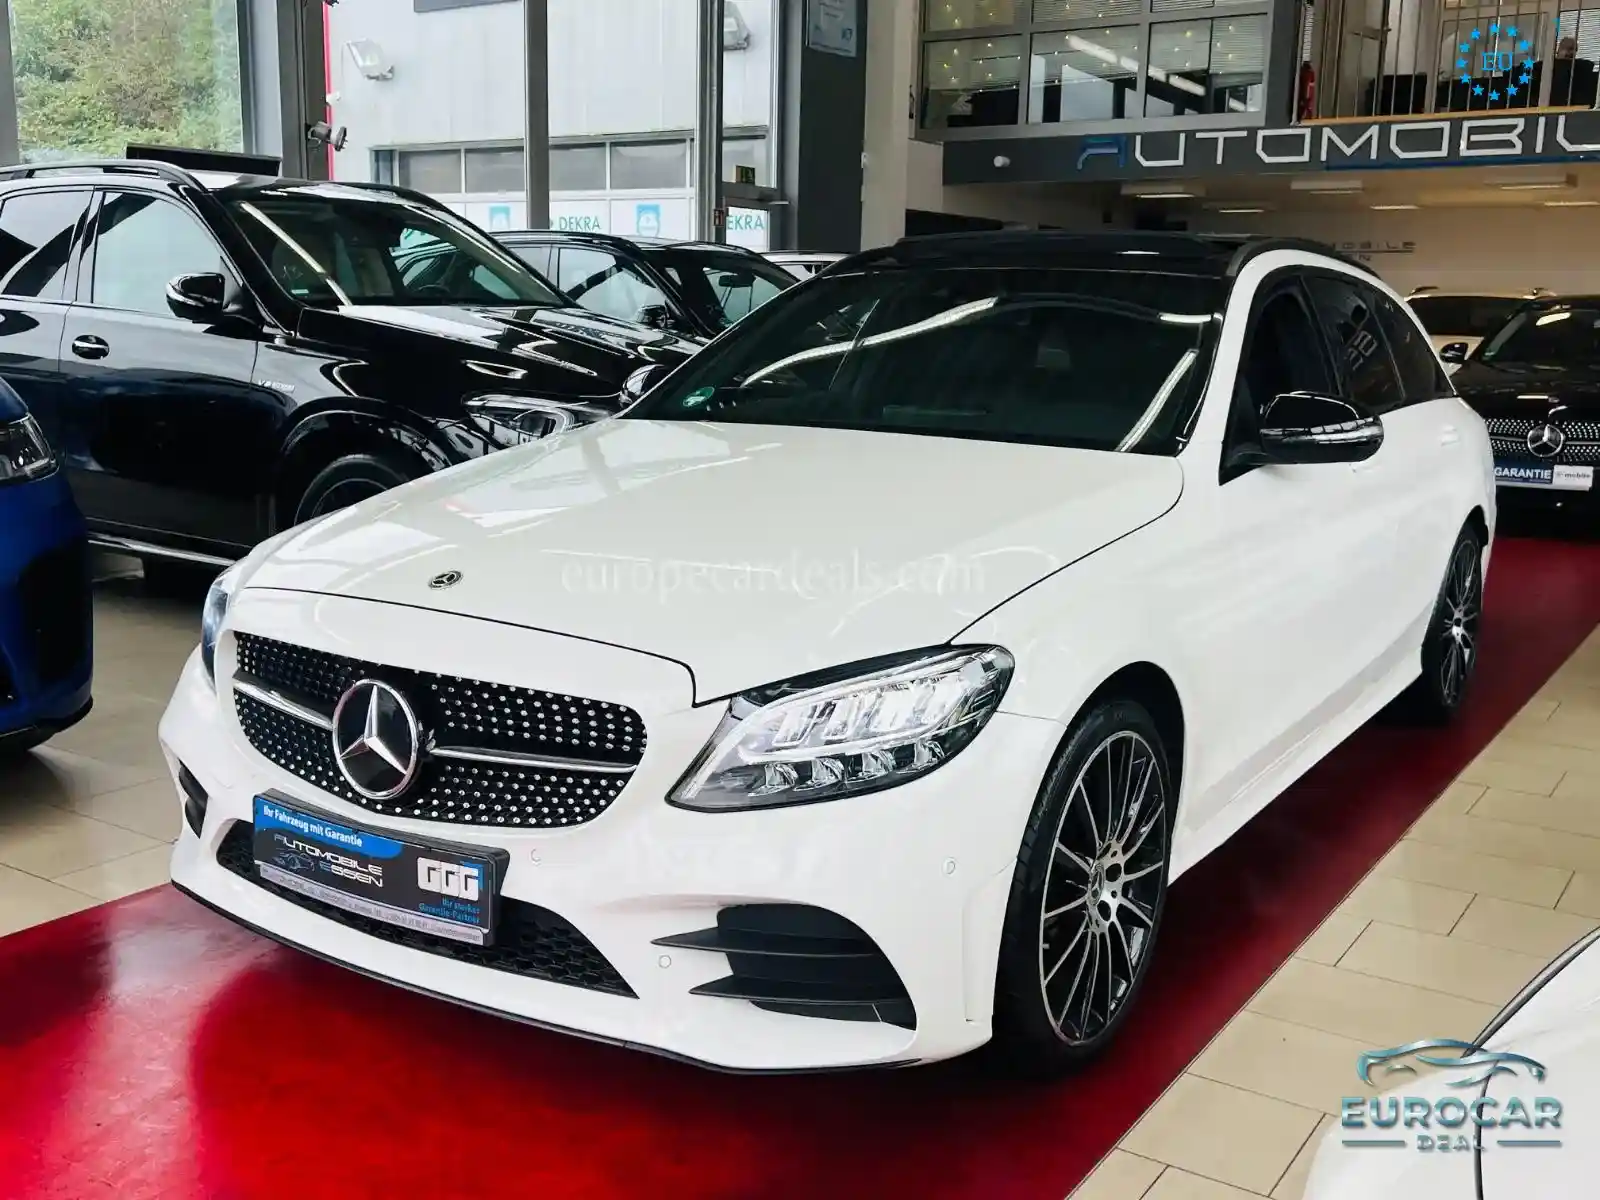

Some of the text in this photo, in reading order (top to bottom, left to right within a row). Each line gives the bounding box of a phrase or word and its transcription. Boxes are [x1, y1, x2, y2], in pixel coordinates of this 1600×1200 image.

[1077, 115, 1600, 170] AUTOMOBIL
[558, 215, 601, 232] DEKRA
[726, 214, 765, 230] EKRA
[1493, 466, 1552, 479] GARANTIE
[263, 803, 363, 848] Ihr Fahrzeug mit Garantie
[273, 833, 383, 876] AUTOMOBILE
[319, 860, 383, 888] ESSEN
